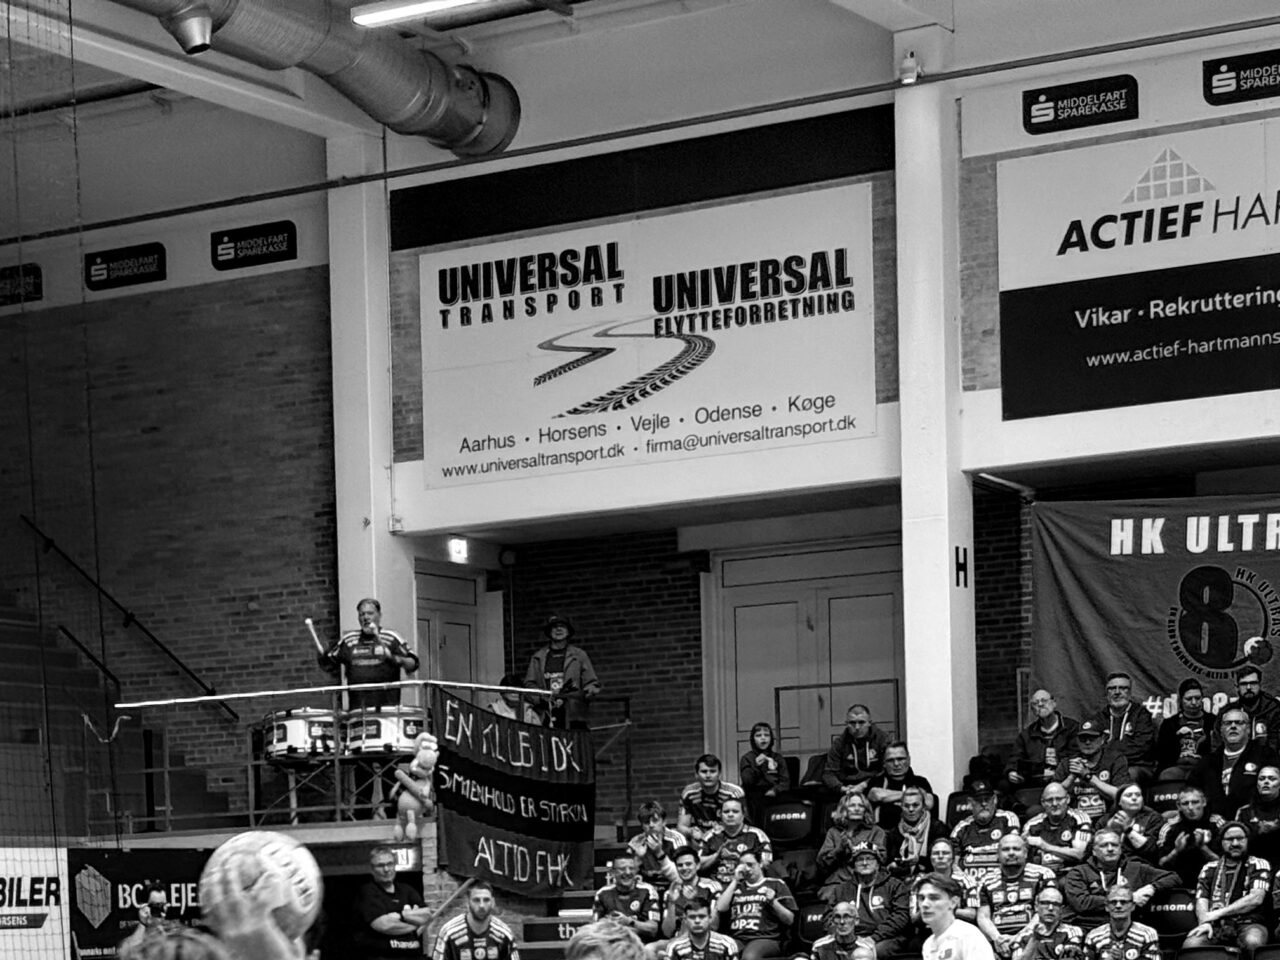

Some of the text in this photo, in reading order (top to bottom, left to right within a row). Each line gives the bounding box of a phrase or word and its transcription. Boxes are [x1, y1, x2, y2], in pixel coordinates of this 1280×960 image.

[1058, 89, 1127, 109] MIDDELFART
[1058, 101, 1127, 119] SPAREKASSE
[237, 233, 288, 250] MIDDELFART
[1056, 201, 1204, 256] ACTIEF
[438, 242, 624, 305] UNIVERSAL
[653, 248, 854, 314] UNIVERSAL
[439, 283, 625, 329] TRANSPORT
[654, 290, 856, 338] FLYTTEFORRETNING
[1075, 307, 1132, 328] Vikar
[441, 414, 857, 479] www.universaltransport.dk firma@universaltransport.dk
[459, 392, 837, 455] Aarhus Horsens Vejle Odense Køge
[1110, 518, 1166, 555] HK
[954, 546, 969, 588] H
[1236, 566, 1256, 585] HK
[444, 699, 473, 748] EN
[473, 836, 575, 887] ALTID FHK
